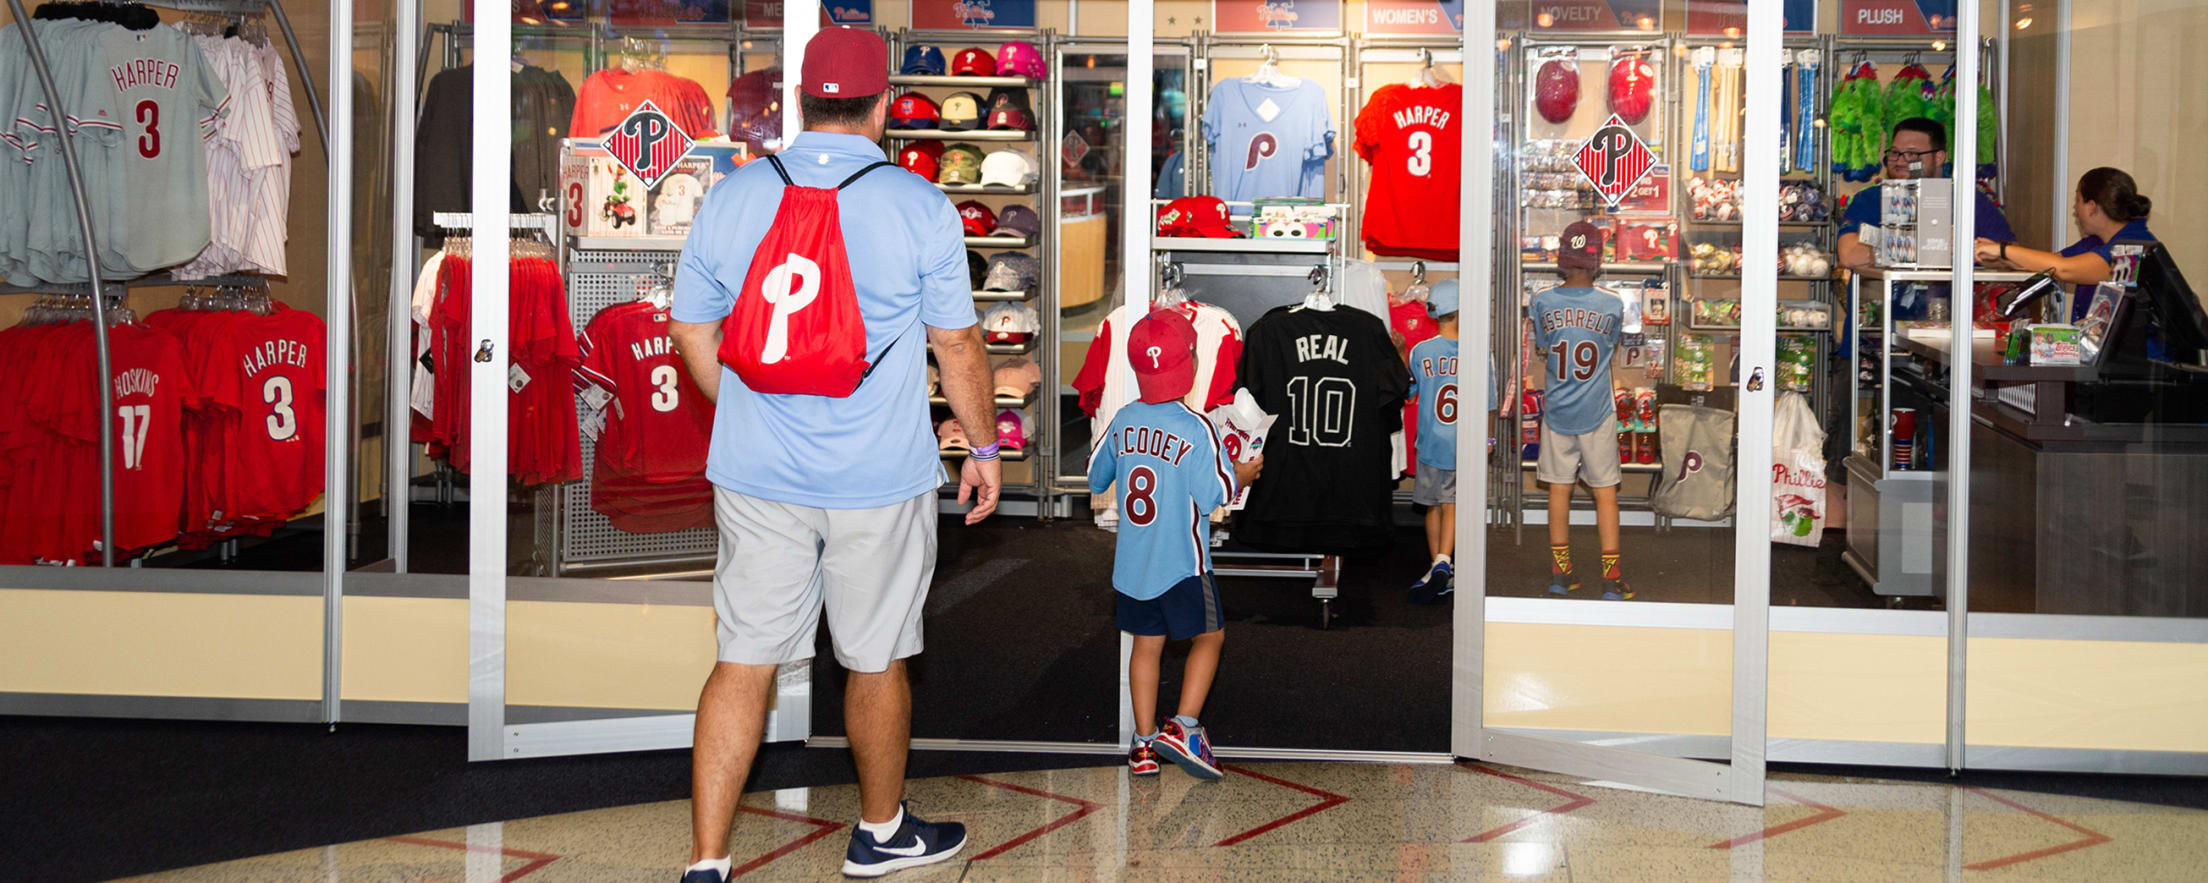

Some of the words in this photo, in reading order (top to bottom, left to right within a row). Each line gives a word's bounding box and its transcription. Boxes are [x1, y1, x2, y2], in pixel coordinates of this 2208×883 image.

[1372, 8, 1438, 25] WOMEN'S
[1857, 8, 1903, 25] PLUSH
[109, 58, 181, 93] HARPER
[135, 99, 162, 159] 3
[1393, 105, 1450, 130] HARPER
[1407, 130, 1432, 177] 3
[568, 182, 583, 228] 3
[243, 338, 308, 378] HARPER
[630, 335, 680, 361] HARP
[1295, 334, 1349, 366] REAL
[1551, 339, 1599, 381] 19
[114, 368, 160, 399] HOSKINS
[650, 364, 679, 412] 3
[1433, 382, 1459, 426] 6
[262, 375, 298, 441] 3
[1286, 376, 1356, 447] 10
[118, 404, 151, 469] 17
[1112, 426, 1194, 468] .COOEY
[1125, 464, 1158, 528] 8
